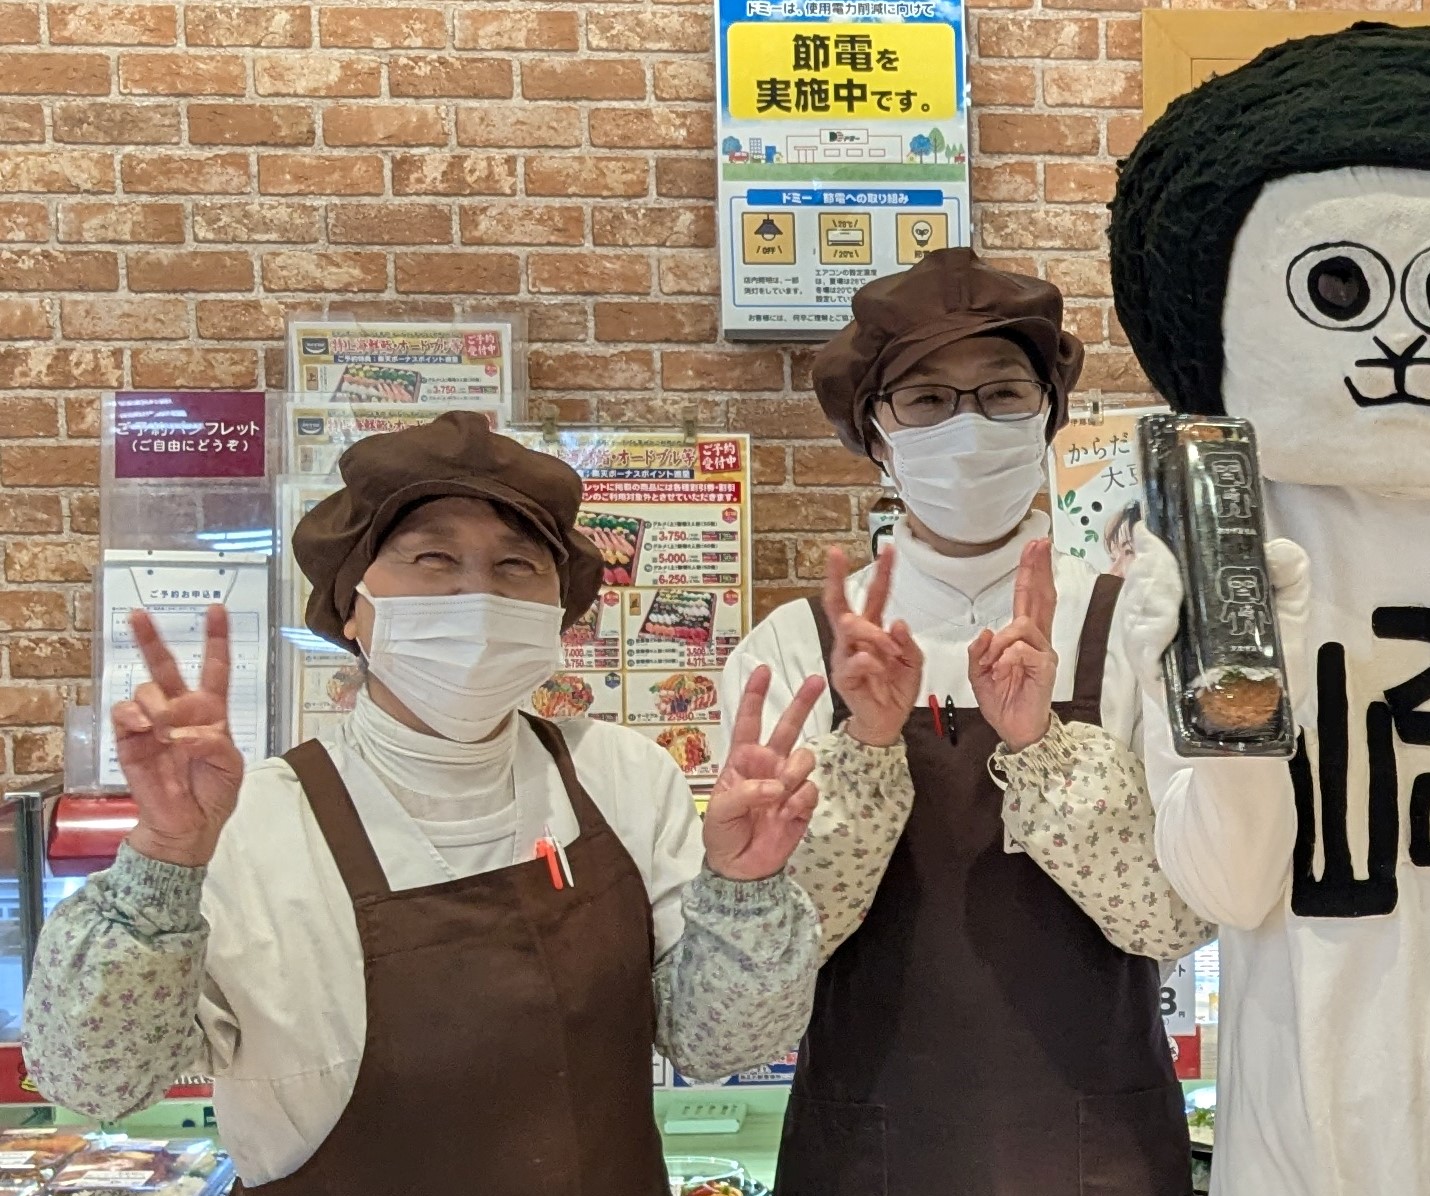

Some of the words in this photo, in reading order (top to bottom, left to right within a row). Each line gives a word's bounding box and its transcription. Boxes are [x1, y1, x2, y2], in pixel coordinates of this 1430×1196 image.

[747, 2, 935, 16] ドミーは、使用電力削減に向けて
[793, 33, 900, 73] 節電を
[756, 78, 931, 114] 実施中です。
[782, 193, 813, 204] ドミー
[823, 193, 909, 205] 節電への取り組み
[131, 439, 249, 452] （ご自由にどうぞ）
[702, 442, 736, 455] ご予約
[1068, 432, 1130, 465] からだ
[702, 455, 737, 471] 受付中
